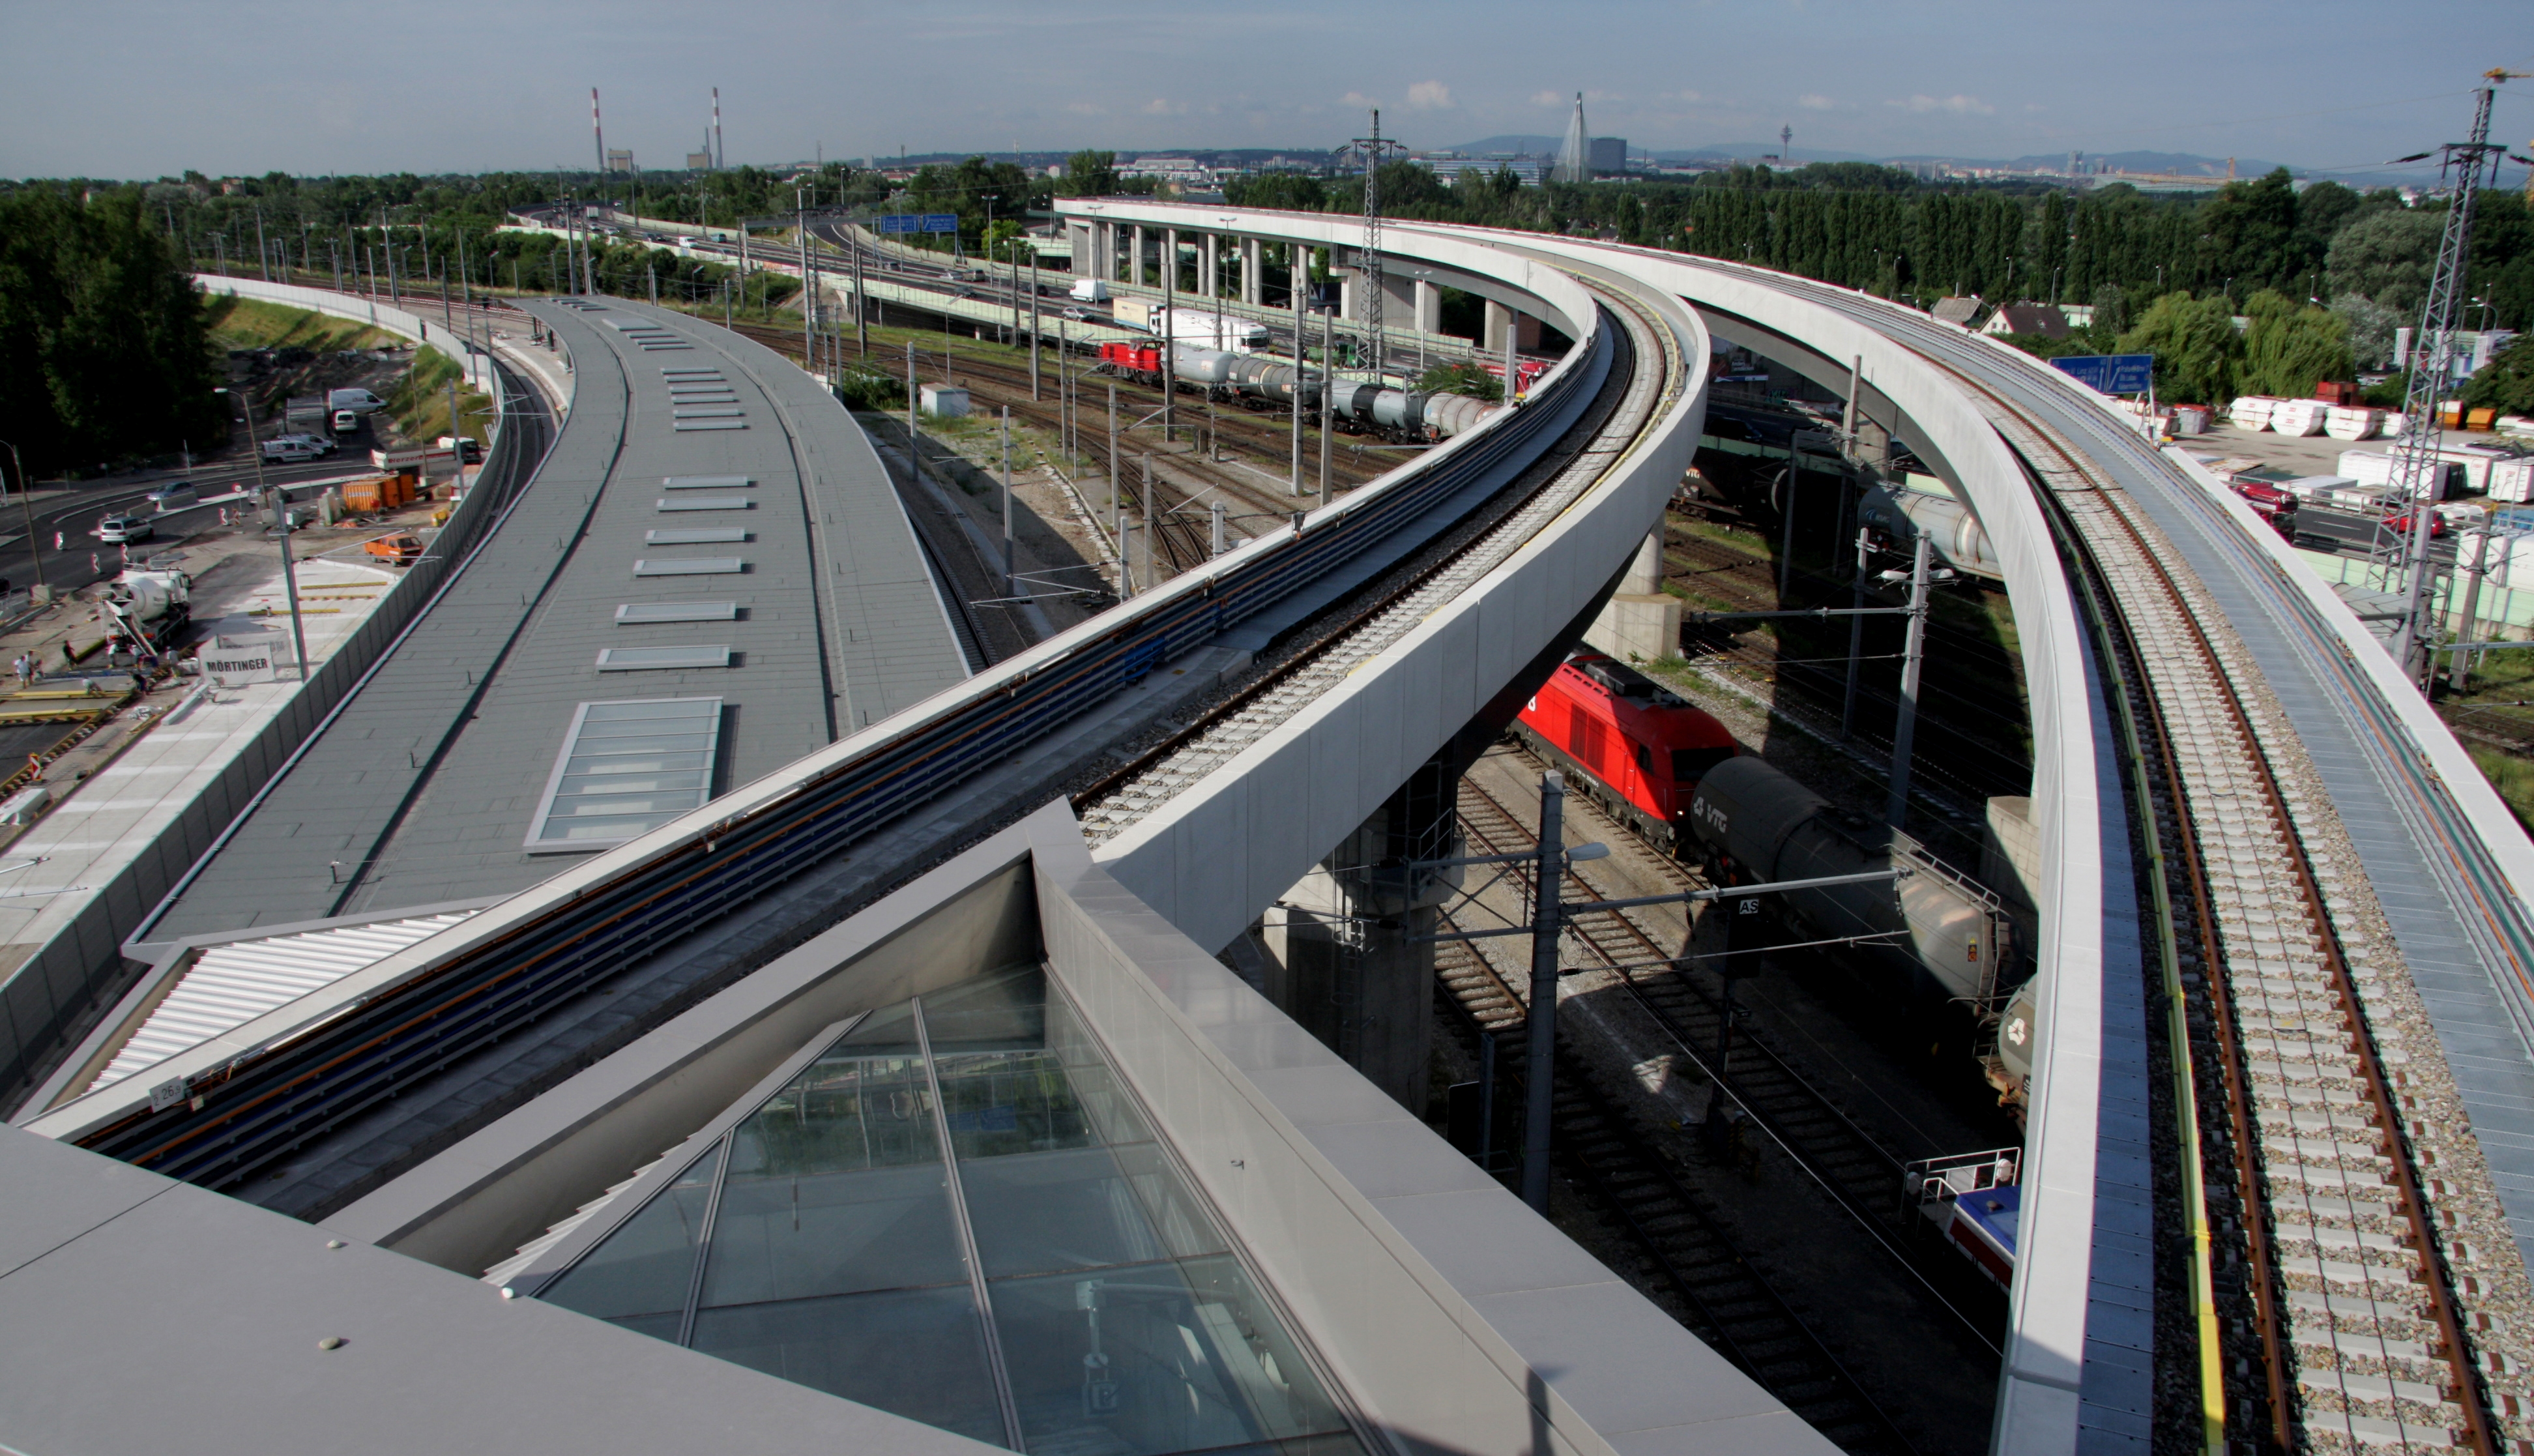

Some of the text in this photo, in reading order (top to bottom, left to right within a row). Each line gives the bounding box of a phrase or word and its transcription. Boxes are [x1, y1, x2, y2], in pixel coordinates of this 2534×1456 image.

[207, 658, 268, 672] MÖRTINGER
[1707, 804, 1727, 834] VTG
[1740, 901, 1758, 912] AS
